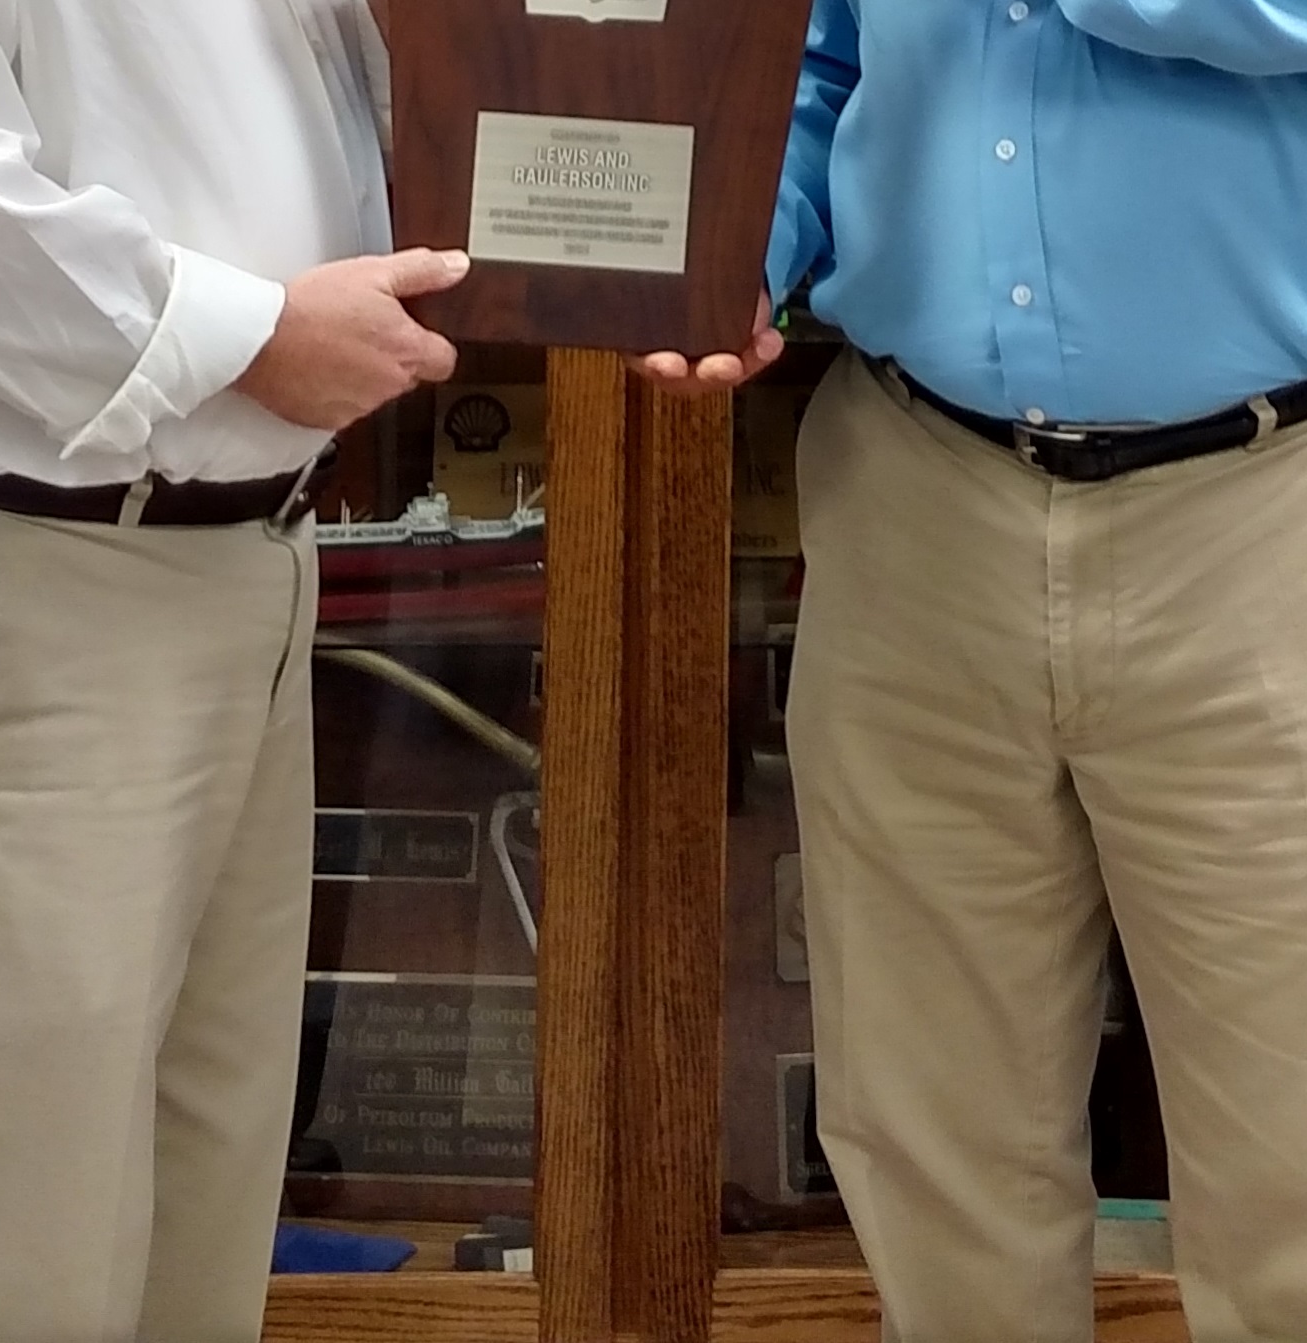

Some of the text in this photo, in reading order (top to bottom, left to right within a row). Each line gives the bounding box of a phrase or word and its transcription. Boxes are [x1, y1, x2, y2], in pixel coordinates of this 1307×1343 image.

[537, 145, 630, 169] LEWIS AND
[513, 166, 651, 193] RAULERSON INC
[412, 533, 454, 547] TEXACO
